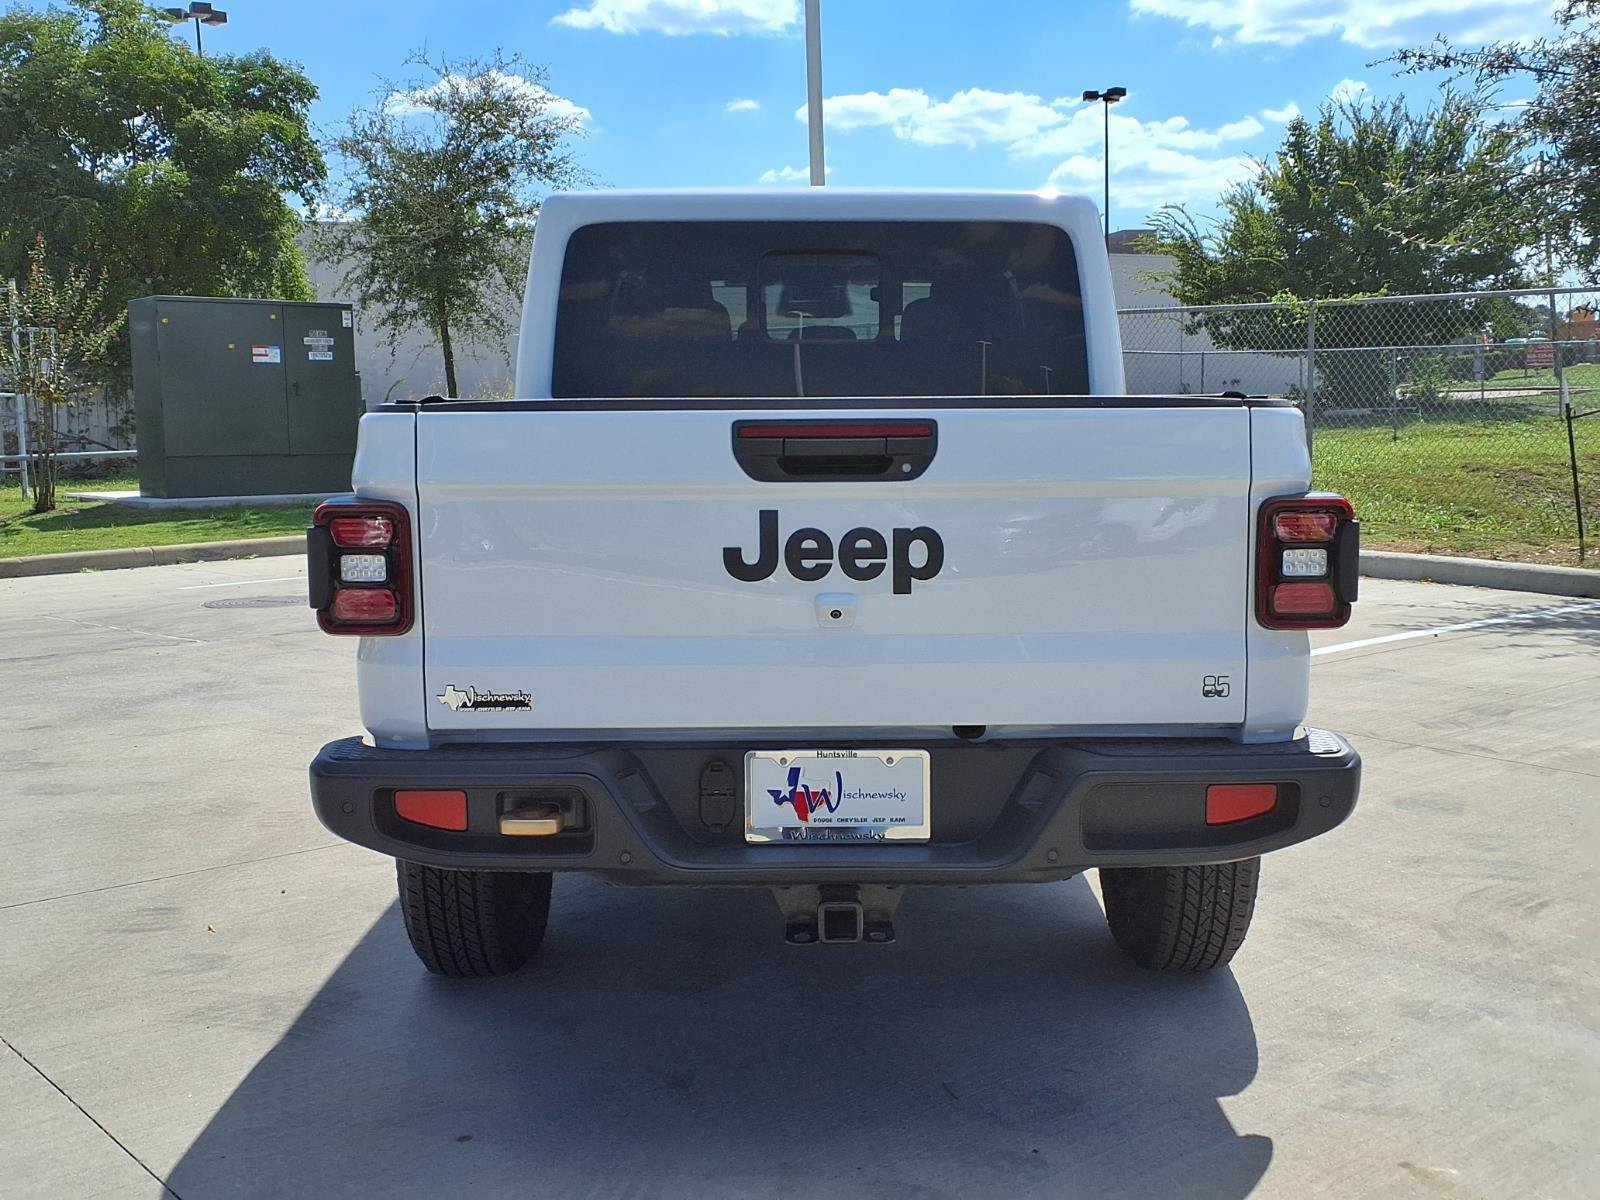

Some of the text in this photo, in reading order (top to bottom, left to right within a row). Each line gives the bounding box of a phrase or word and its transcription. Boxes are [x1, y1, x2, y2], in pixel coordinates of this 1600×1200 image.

[723, 509, 945, 594] Jeep
[816, 750, 858, 759] Huntsville
[802, 770, 907, 814] Wischnewsky
